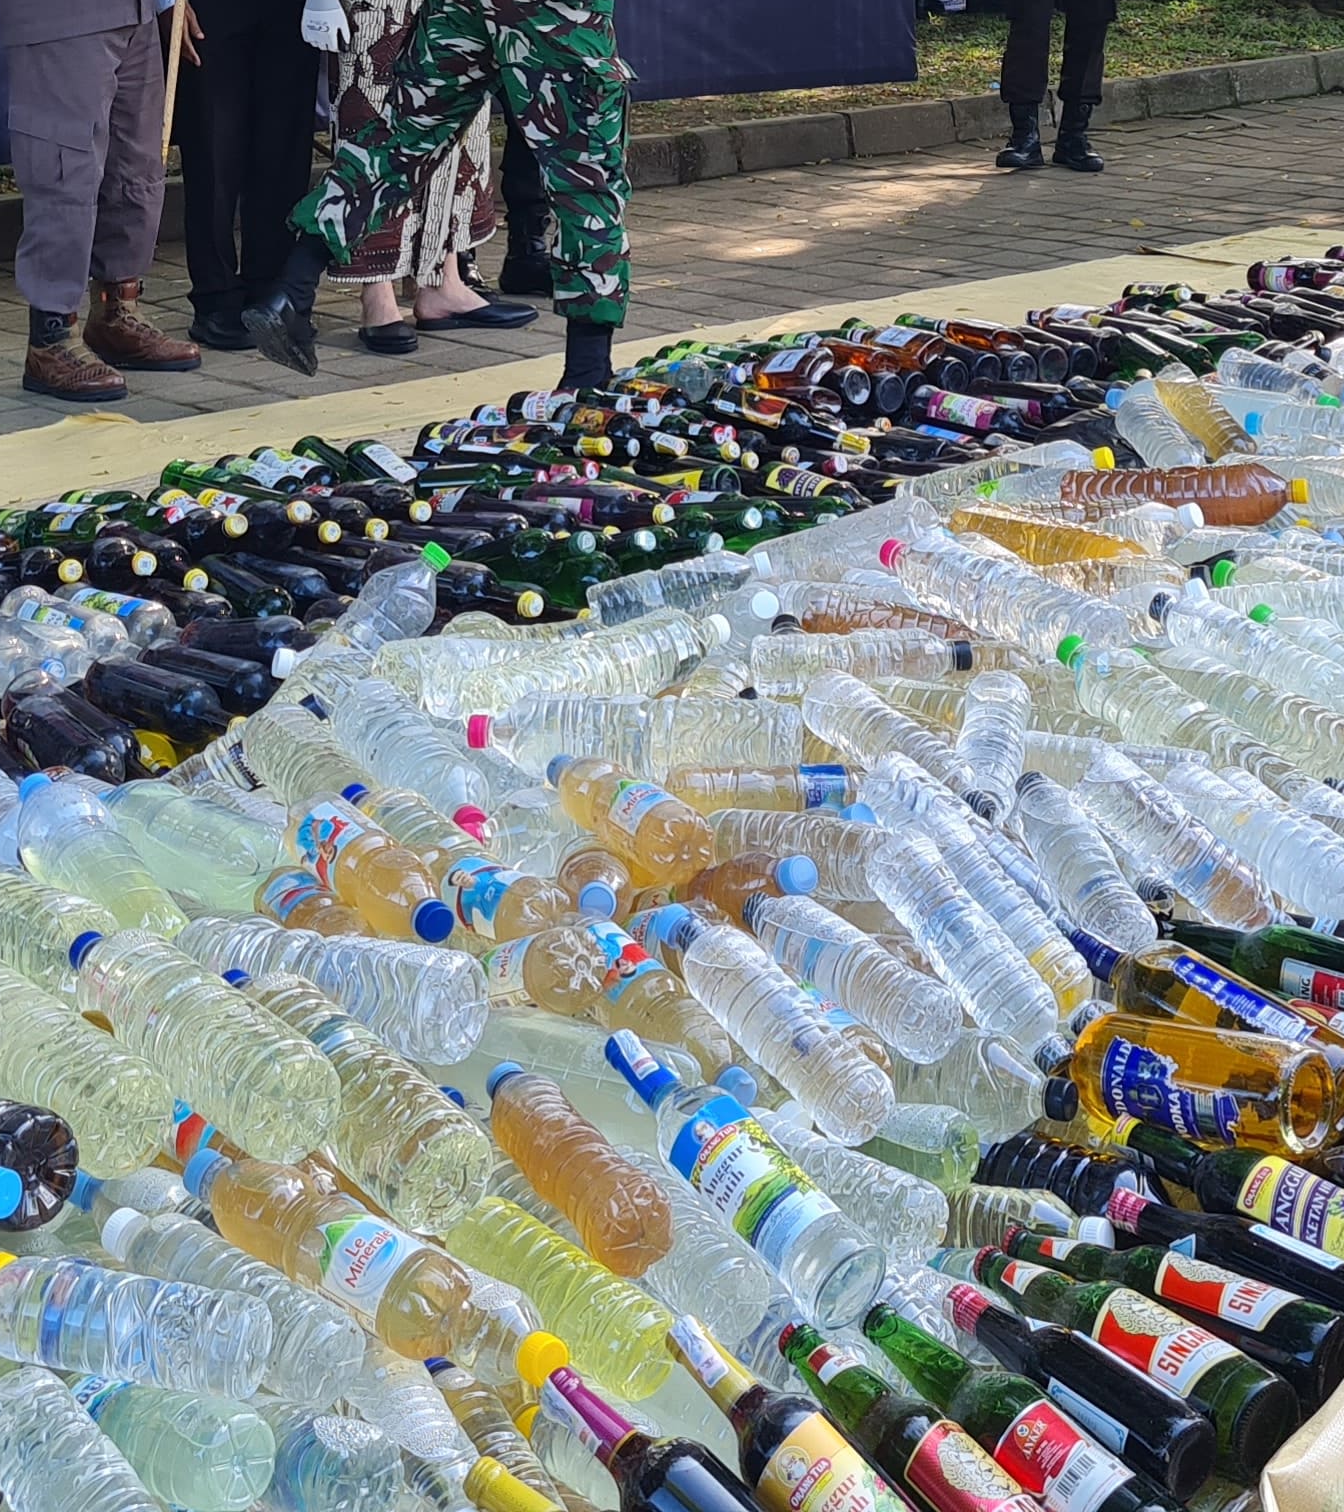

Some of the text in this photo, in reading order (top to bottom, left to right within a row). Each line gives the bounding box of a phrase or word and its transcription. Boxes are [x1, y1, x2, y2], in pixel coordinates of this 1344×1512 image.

[1111, 1041, 1133, 1116] DONALD
[699, 1125, 736, 1162] ORANG TUA
[707, 1144, 746, 1201] Anggur
[716, 1170, 746, 1213] Putih
[344, 1237, 366, 1258] Le
[344, 1229, 393, 1289] Minerale
[1022, 1416, 1048, 1461] ANKER
[789, 1459, 829, 1508] ORANG TUA
[820, 1472, 858, 1512] ggur
